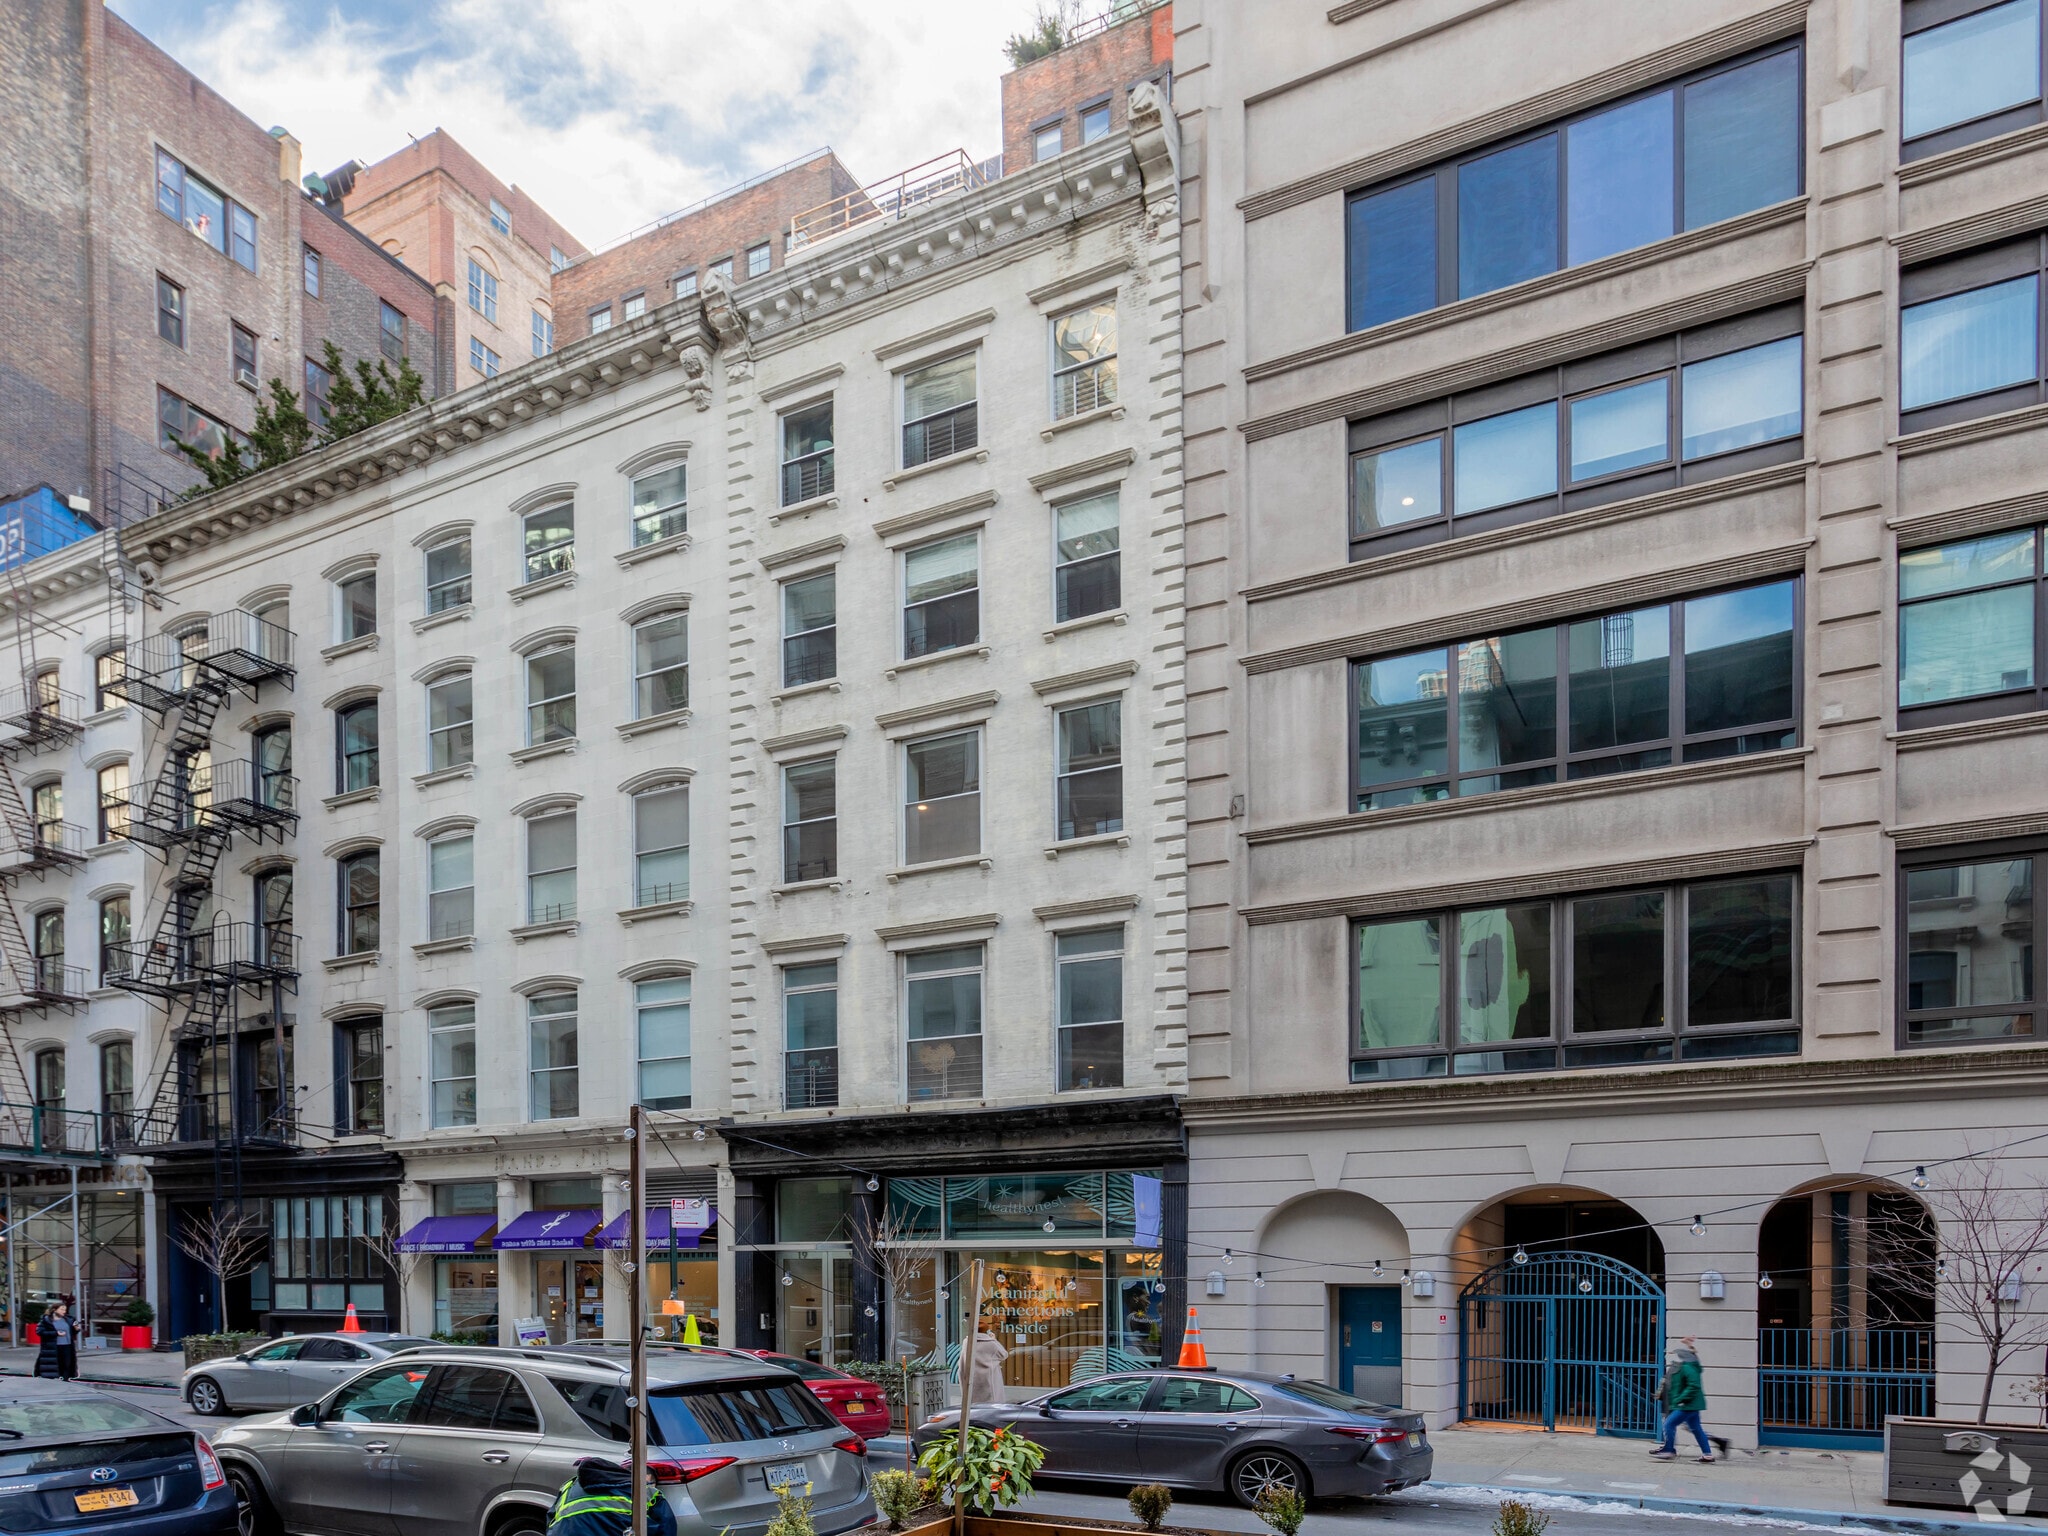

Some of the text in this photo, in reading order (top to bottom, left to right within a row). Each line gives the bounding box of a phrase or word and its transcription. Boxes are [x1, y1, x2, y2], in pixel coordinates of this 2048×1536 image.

[983, 1195, 1064, 1215] healthynest
[448, 1243, 466, 1251] MUSIC
[798, 1251, 807, 1259] 19
[908, 1270, 921, 1279] 21
[980, 1286, 1069, 1302] Meaningful
[979, 1303, 1074, 1317] Connections
[1000, 1321, 1048, 1334] Inside
[1960, 1436, 1981, 1450] 23
